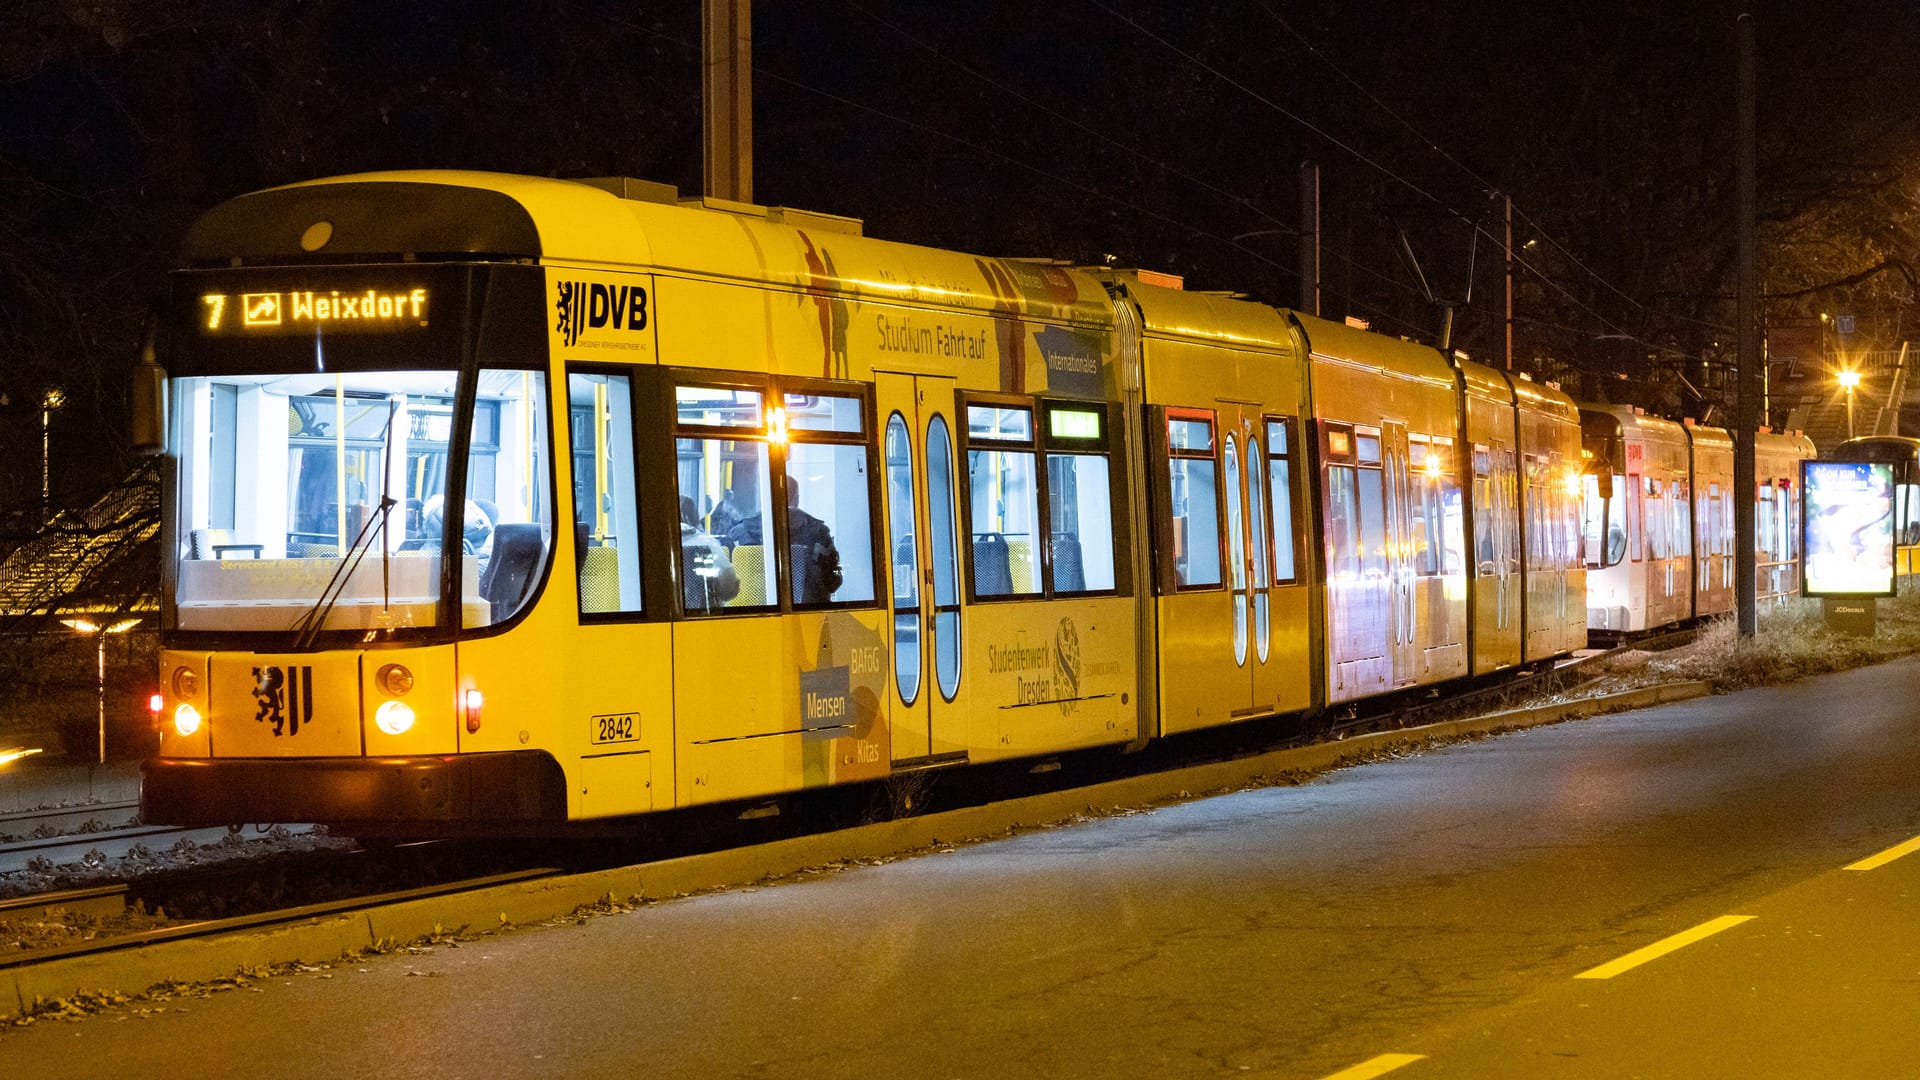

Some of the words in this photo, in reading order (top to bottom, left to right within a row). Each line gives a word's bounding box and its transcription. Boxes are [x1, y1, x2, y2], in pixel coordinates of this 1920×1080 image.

[205, 295, 224, 329] 7
[292, 289, 426, 320] Weixdorf
[589, 283, 647, 331] DVB
[877, 314, 933, 355] Studium
[936, 325, 966, 358] Fahrt
[968, 329, 986, 359] auf
[1048, 350, 1097, 374] Internationales
[988, 641, 1050, 673] Studentenwerk
[1018, 675, 1050, 704] Dresden
[807, 692, 845, 719] Mensen
[599, 716, 632, 740] 2842
[857, 739, 879, 763] Kitas
